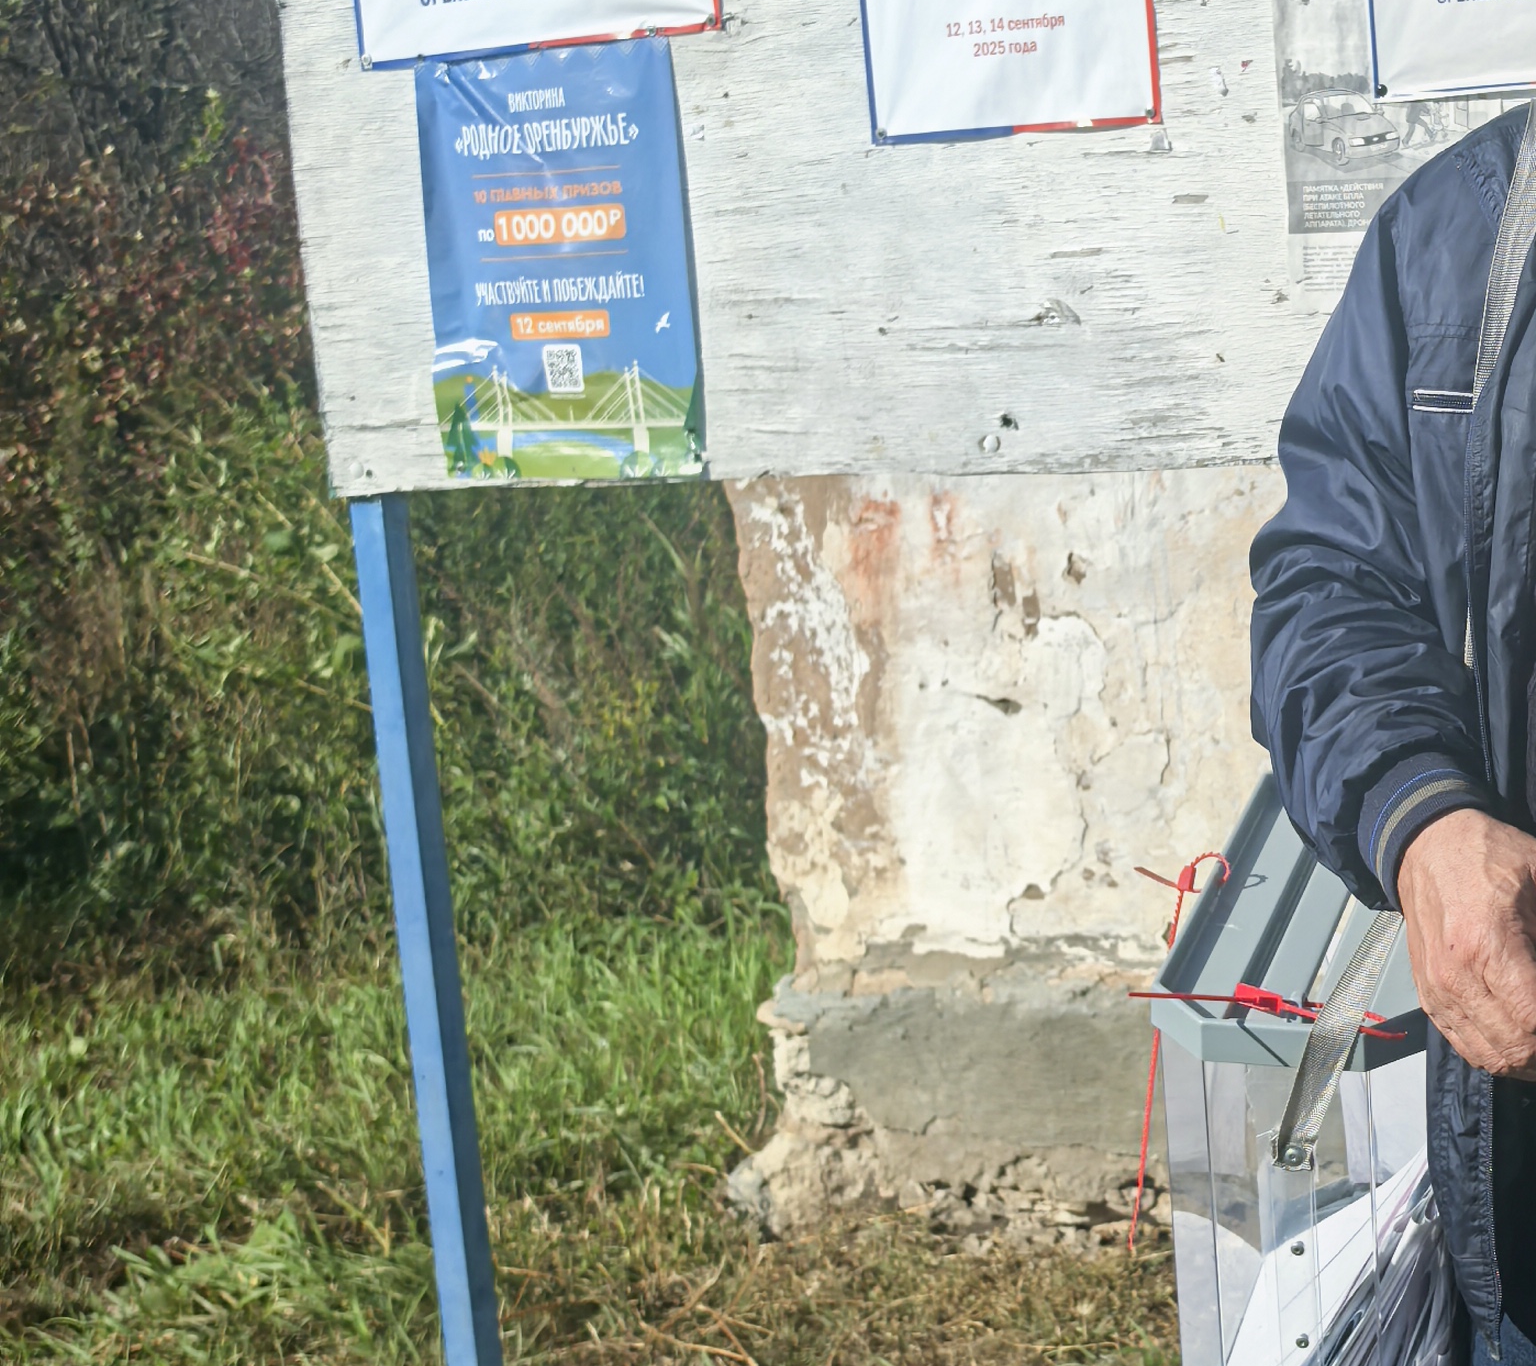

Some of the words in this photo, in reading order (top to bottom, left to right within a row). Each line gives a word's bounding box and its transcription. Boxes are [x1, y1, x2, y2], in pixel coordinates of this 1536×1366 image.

[947, 22, 964, 37] 12,
[968, 20, 987, 35] 13,
[990, 18, 1004, 32] 14
[1008, 13, 1065, 31] сентября
[973, 41, 1005, 57] 2025
[1009, 40, 1037, 55] года
[508, 87, 565, 112] ВИКТОРИНА
[491, 186, 558, 202] ГЛАВНЫХ
[562, 181, 622, 197] ПРИЗОВ
[478, 228, 494, 242] по
[476, 276, 541, 306] УЧАСТВУЙТЕ
[543, 279, 551, 303] И
[555, 271, 645, 304] ПОБЕЖДАЙТЕ!
[516, 317, 533, 334] 12
[538, 315, 604, 334] сентября
